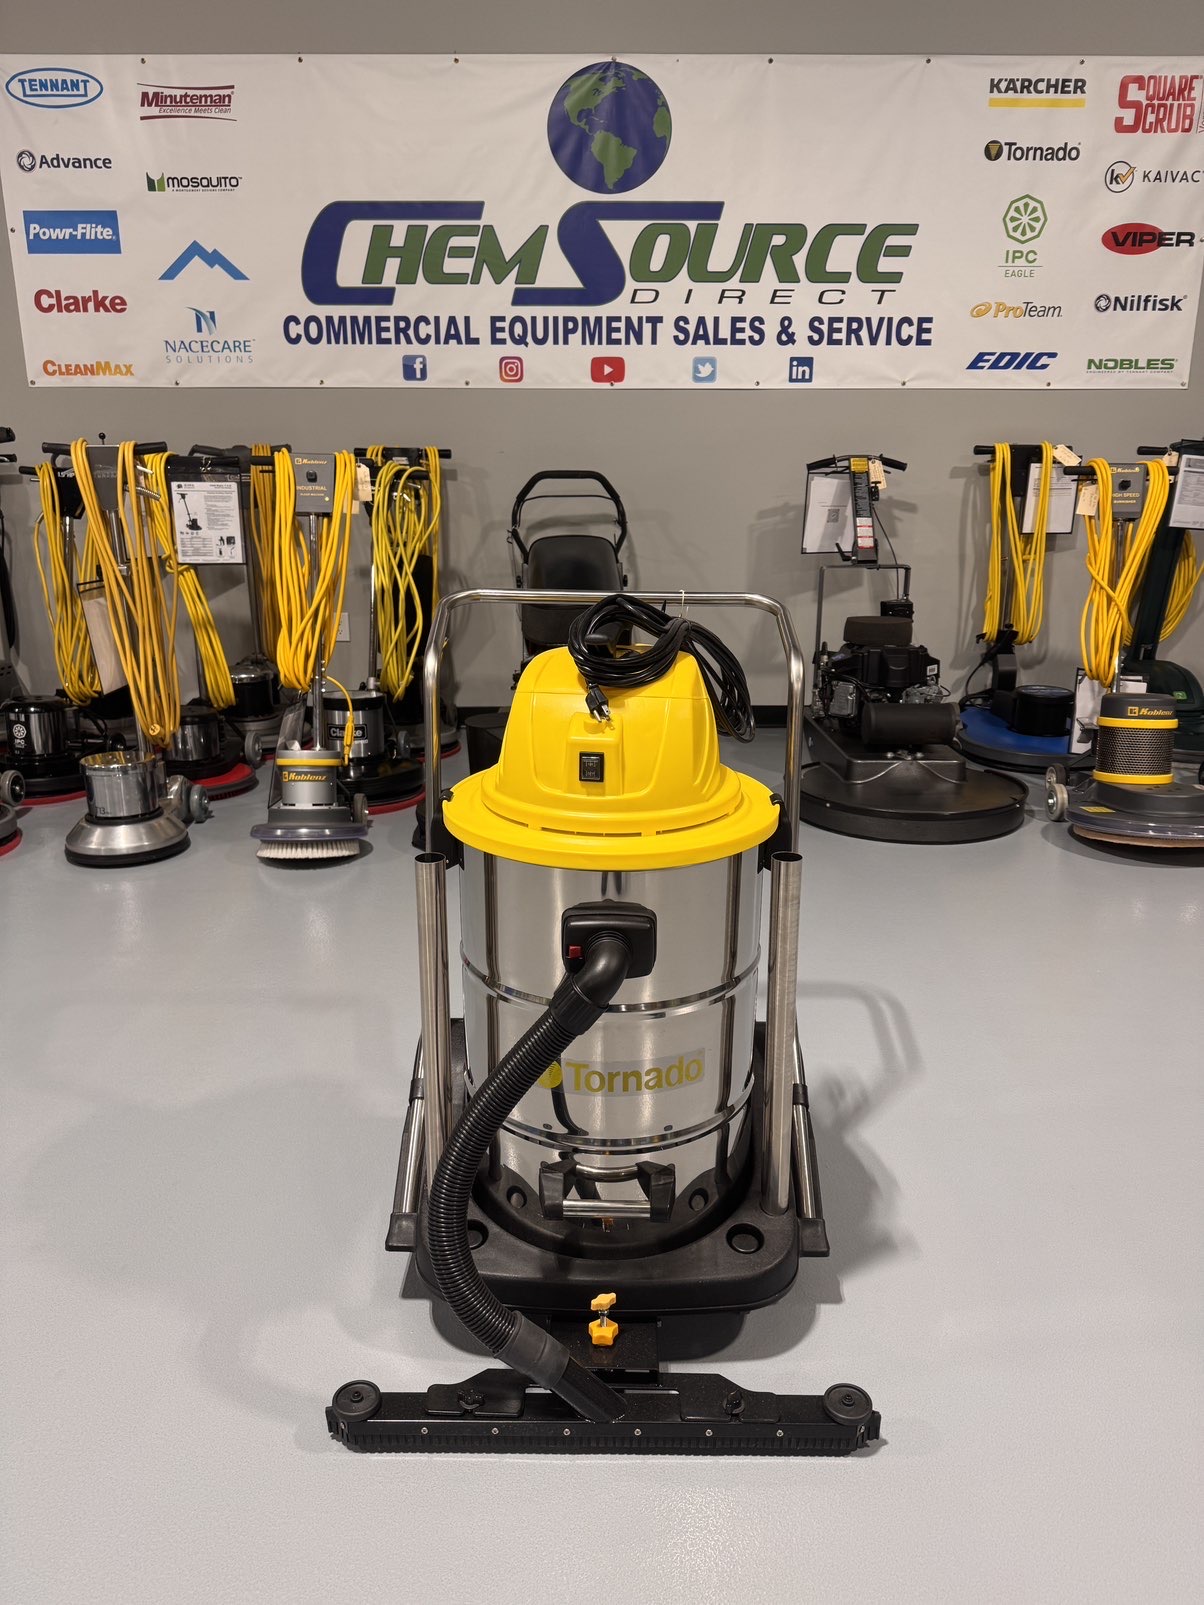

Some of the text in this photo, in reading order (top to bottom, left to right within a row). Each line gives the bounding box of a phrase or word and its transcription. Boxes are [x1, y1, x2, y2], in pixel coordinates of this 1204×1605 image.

[18, 78, 90, 97] TENNANT
[989, 78, 1087, 94] KÄRCHER
[140, 91, 232, 108] Minuteman
[1114, 102, 1196, 134] SCRUB
[1005, 142, 1081, 161] Tornado
[38, 154, 112, 169] Advance
[166, 176, 239, 188] MOSQUITO
[29, 223, 113, 240] Powr-Flite
[1111, 231, 1196, 248] VIPER
[1005, 250, 1038, 264] IPC
[1004, 269, 1035, 278] EAGLE
[34, 289, 128, 314] Clarke
[629, 288, 896, 305] DIRECT
[1113, 295, 1183, 312] Nilfisk
[993, 301, 1062, 319] ProTeam
[283, 315, 934, 347] COMMERCIAL EQUIPMENT SALES & SERVICE
[164, 339, 252, 353] NACECARE
[43, 359, 134, 376] CLEANMAX
[166, 355, 253, 364] SOLUTIONS
[965, 352, 1058, 370] EDIC
[1087, 358, 1175, 370] NOBLES
[288, 772, 327, 780] Koblenz
[565, 1056, 704, 1092] Tornado
